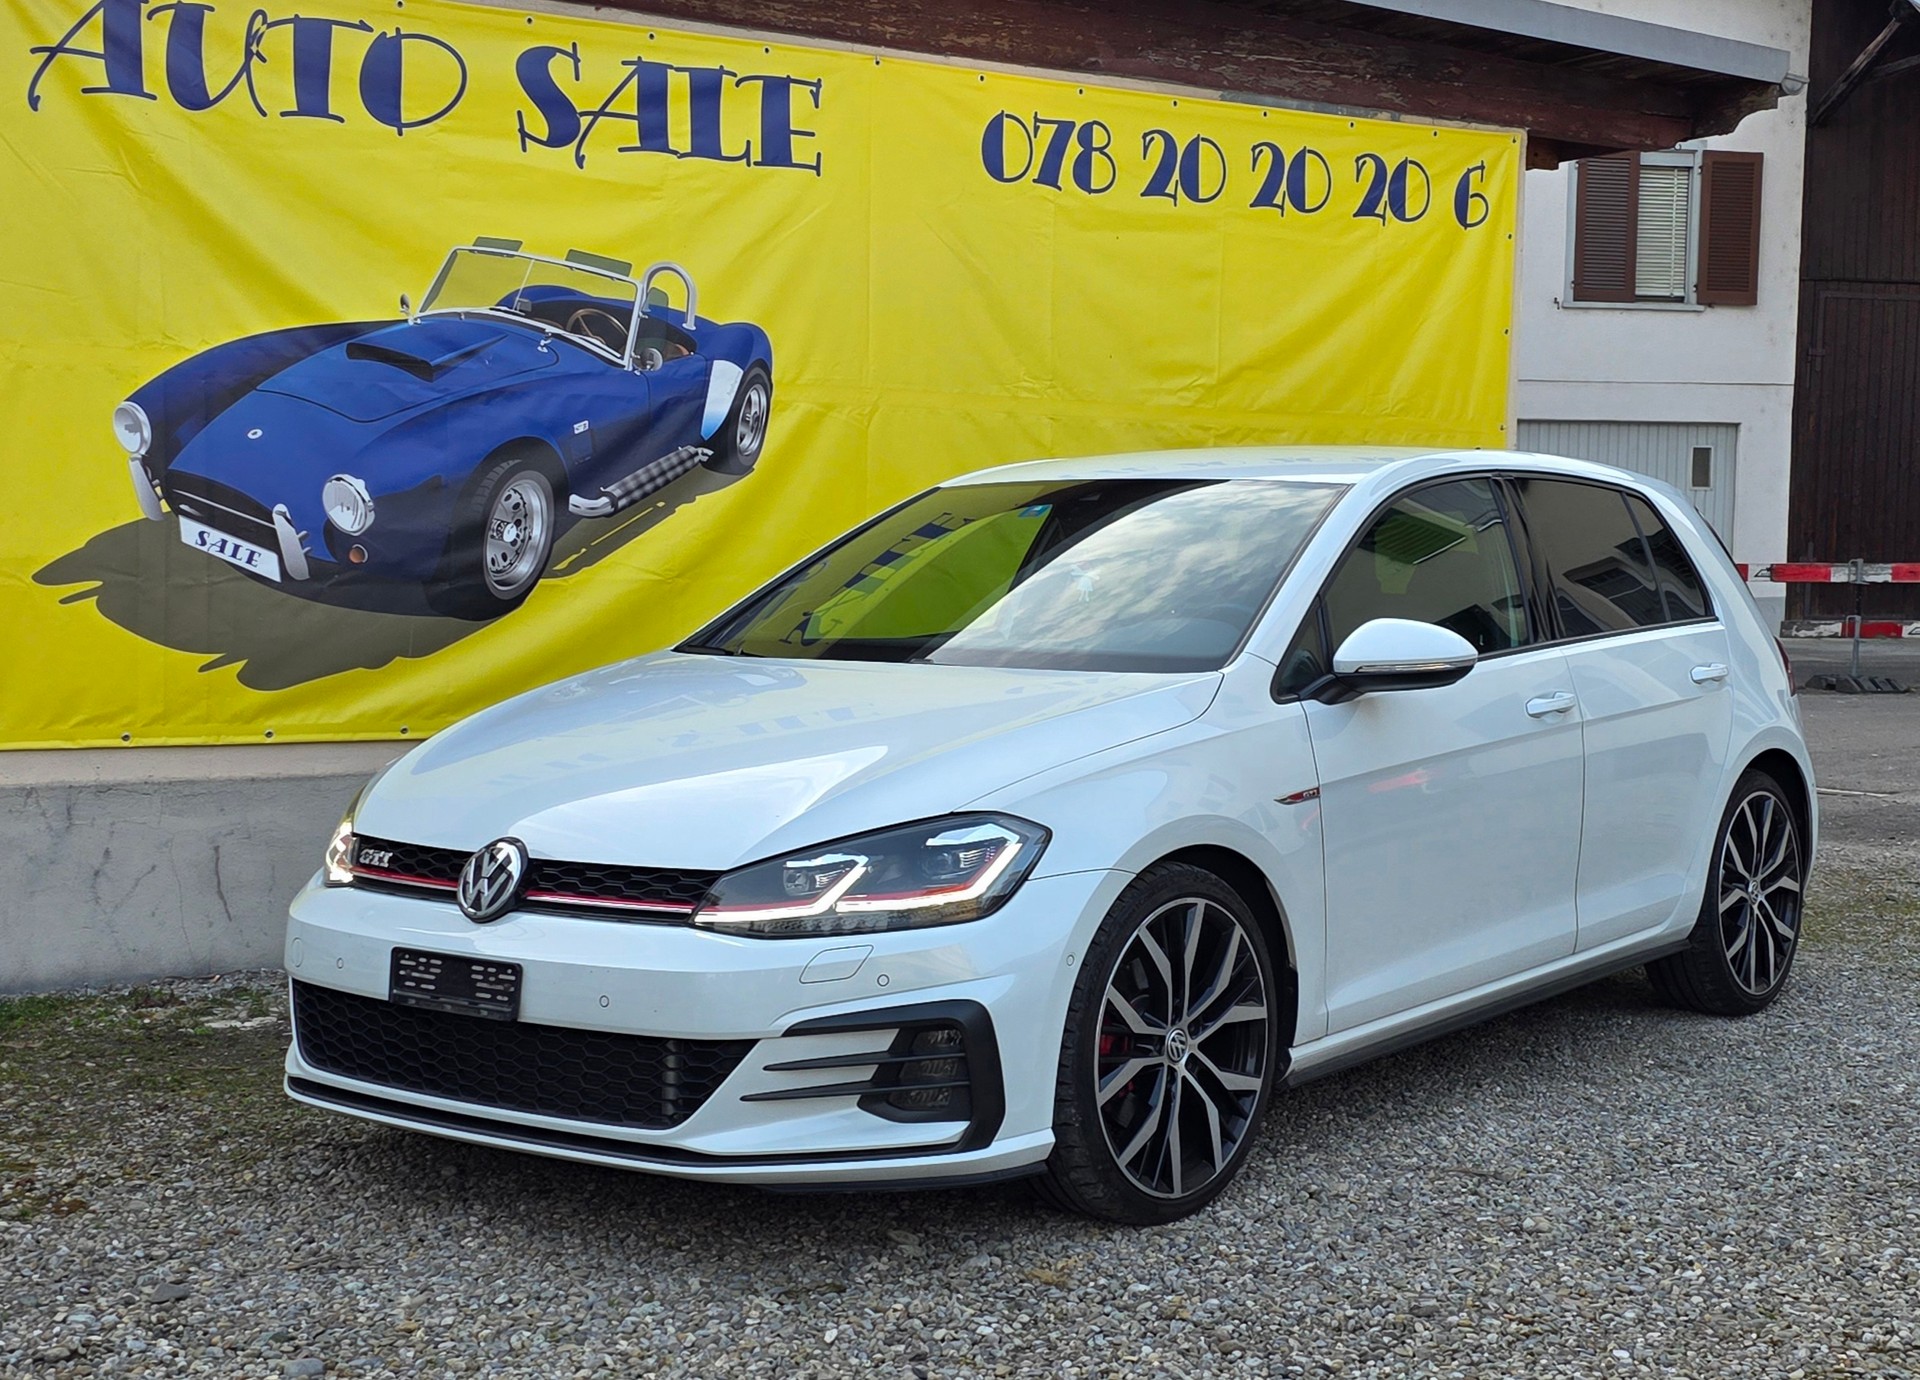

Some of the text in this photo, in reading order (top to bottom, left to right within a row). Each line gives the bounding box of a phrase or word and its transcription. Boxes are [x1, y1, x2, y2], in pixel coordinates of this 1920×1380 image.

[28, 0, 823, 177] AUTO SALE
[981, 110, 1490, 230] 078 20 20 20 6
[195, 530, 262, 568] SALE
[359, 848, 394, 868] GTI
[458, 839, 523, 919] VW
